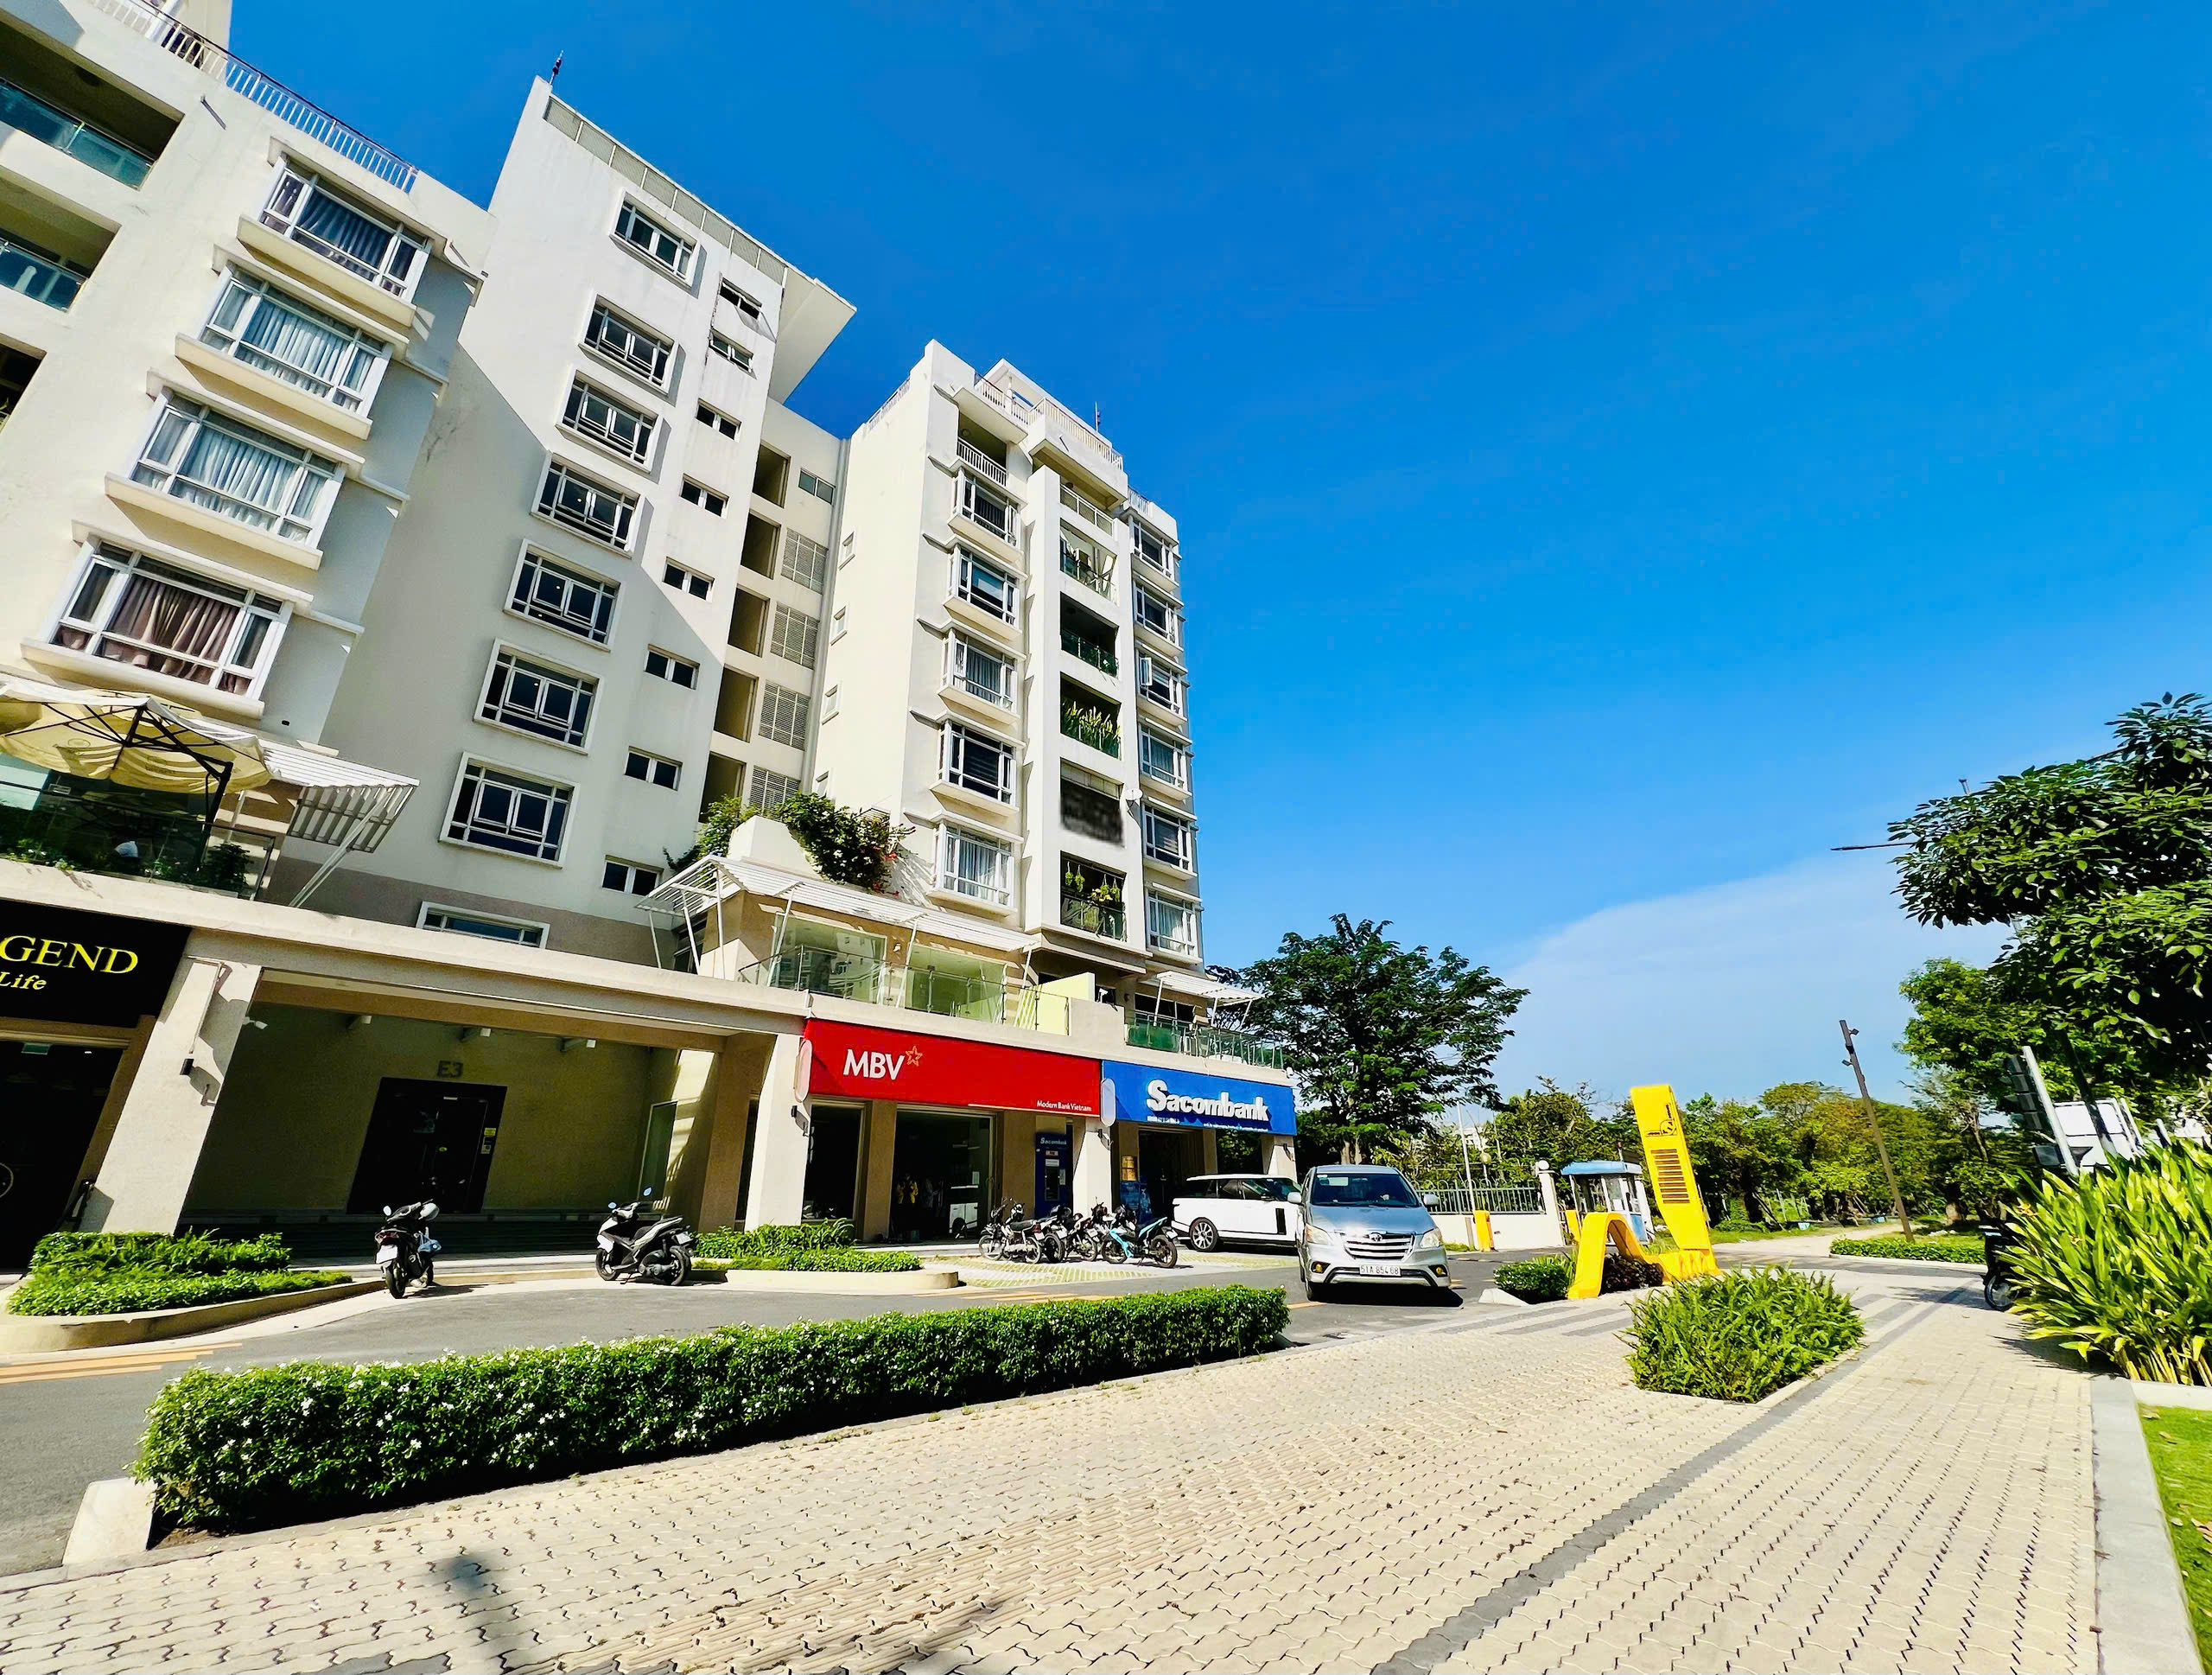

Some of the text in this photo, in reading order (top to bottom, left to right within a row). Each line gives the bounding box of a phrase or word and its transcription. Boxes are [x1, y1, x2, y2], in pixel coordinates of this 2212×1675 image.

[0, 935, 138, 973] GEND
[0, 971, 47, 990] Life
[437, 1060, 463, 1078] E3
[843, 1048, 906, 1080] MBV
[1037, 1099, 1058, 1109] Modern
[1071, 1103, 1092, 1111] Vietnam
[1146, 1080, 1269, 1122] Sacombank
